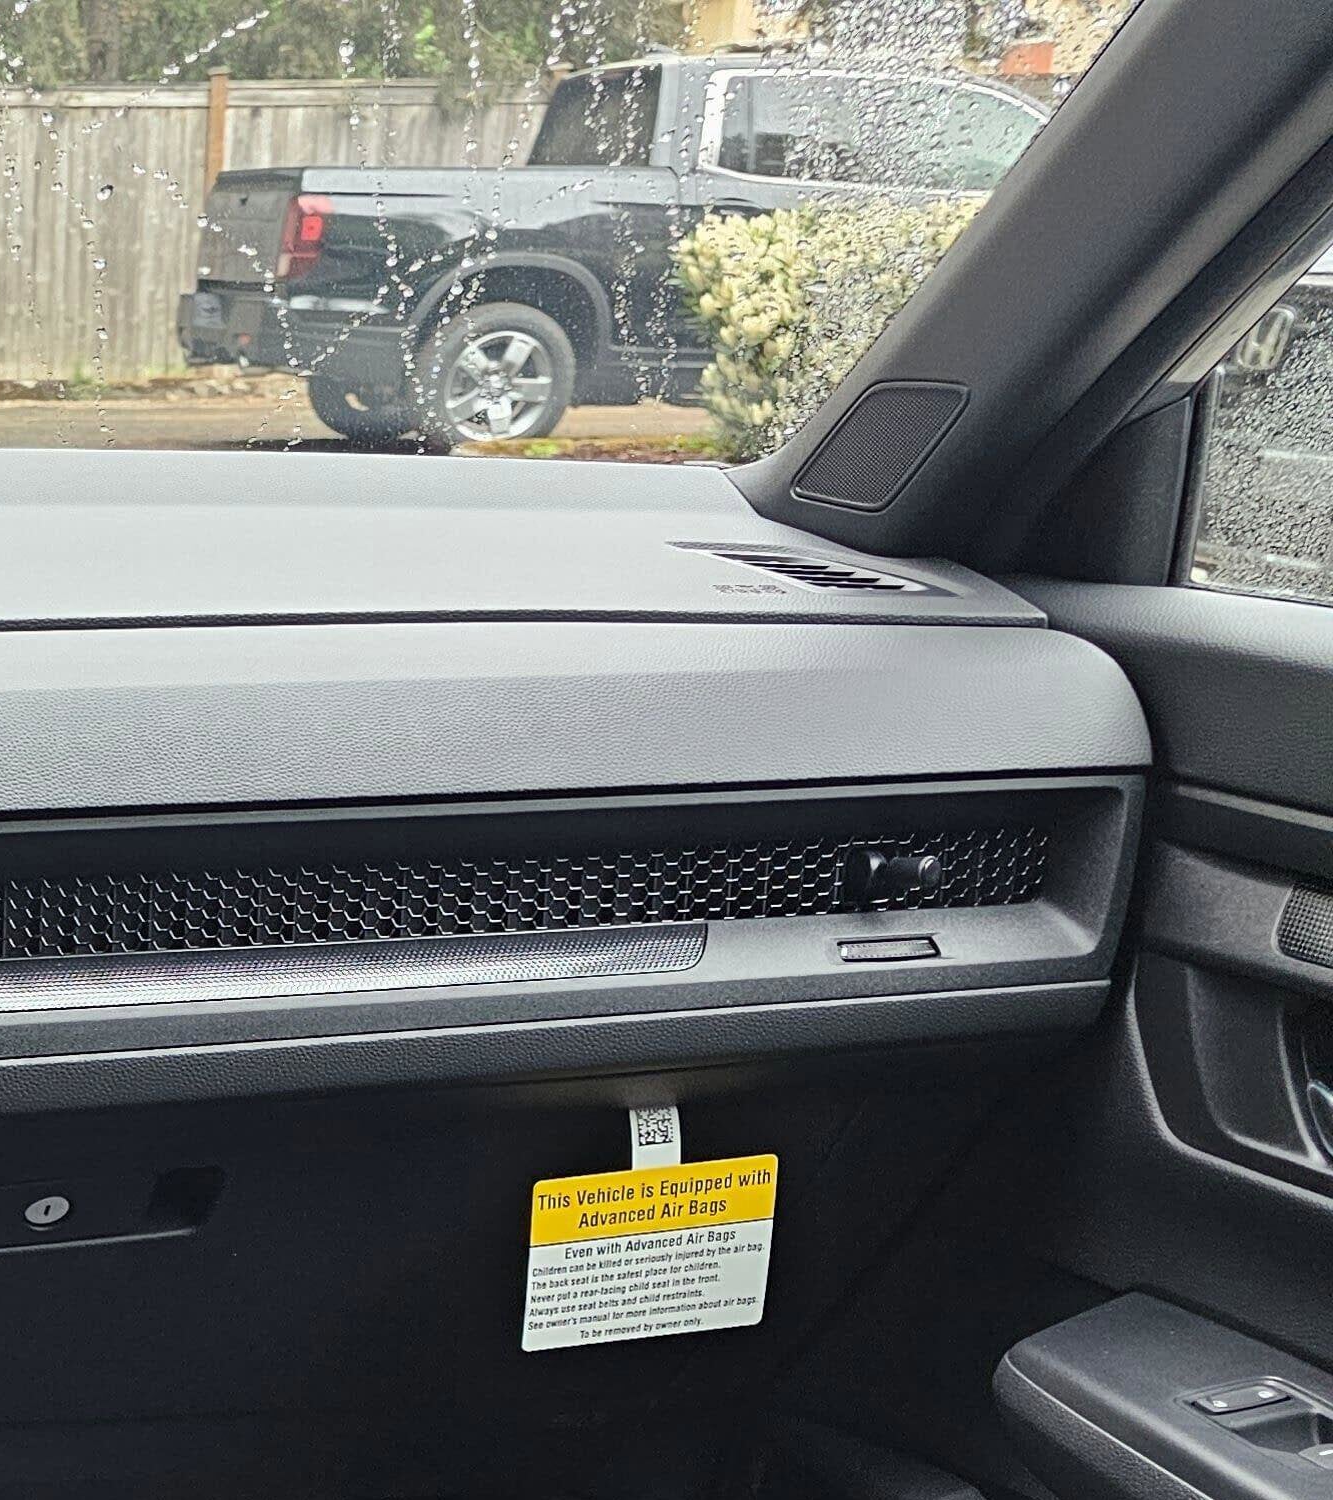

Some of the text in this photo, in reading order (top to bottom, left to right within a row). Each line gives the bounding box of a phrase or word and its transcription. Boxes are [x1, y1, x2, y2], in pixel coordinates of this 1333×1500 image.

[538, 1168, 771, 1211] This Vehicle is Equipped with
[578, 1199, 727, 1229] Advanced Air Bags
[565, 1230, 737, 1260] Even with Advanced Air Bags
[532, 1266, 568, 1278] Children
[569, 1264, 584, 1273] can
[586, 1260, 597, 1270] be
[599, 1258, 622, 1269] killed
[624, 1257, 633, 1266] or
[635, 1251, 673, 1265] seriously
[675, 1248, 704, 1262] injured
[706, 1247, 716, 1257] by
[718, 1246, 731, 1255] the
[733, 1243, 745, 1253] air
[530, 1294, 555, 1304] Never
[557, 1291, 571, 1302] put
[628, 1281, 650, 1292] child
[652, 1279, 670, 1290] seat
[672, 1278, 680, 1287] in
[682, 1276, 695, 1286] the
[532, 1280, 547, 1290] The
[549, 1278, 569, 1289] back
[571, 1275, 589, 1286] seat
[591, 1274, 599, 1283] is
[601, 1272, 614, 1282] the
[617, 1269, 642, 1280] safest
[645, 1265, 667, 1278] place
[670, 1263, 682, 1274] for
[528, 1321, 544, 1331] See
[579, 1312, 610, 1323] manual
[613, 1310, 624, 1320] for
[625, 1309, 647, 1318] more
[649, 1303, 696, 1316] information
[698, 1299, 721, 1310] about
[723, 1297, 735, 1307] air
[529, 1306, 559, 1317] Always
[561, 1304, 576, 1313] use
[578, 1301, 597, 1311] seat
[599, 1298, 619, 1309] belts
[621, 1296, 637, 1306] and
[639, 1292, 660, 1303] child
[580, 1329, 589, 1339] To
[591, 1328, 602, 1338] be
[604, 1323, 641, 1336] removed
[643, 1322, 653, 1332] by
[655, 1320, 682, 1330] owner
